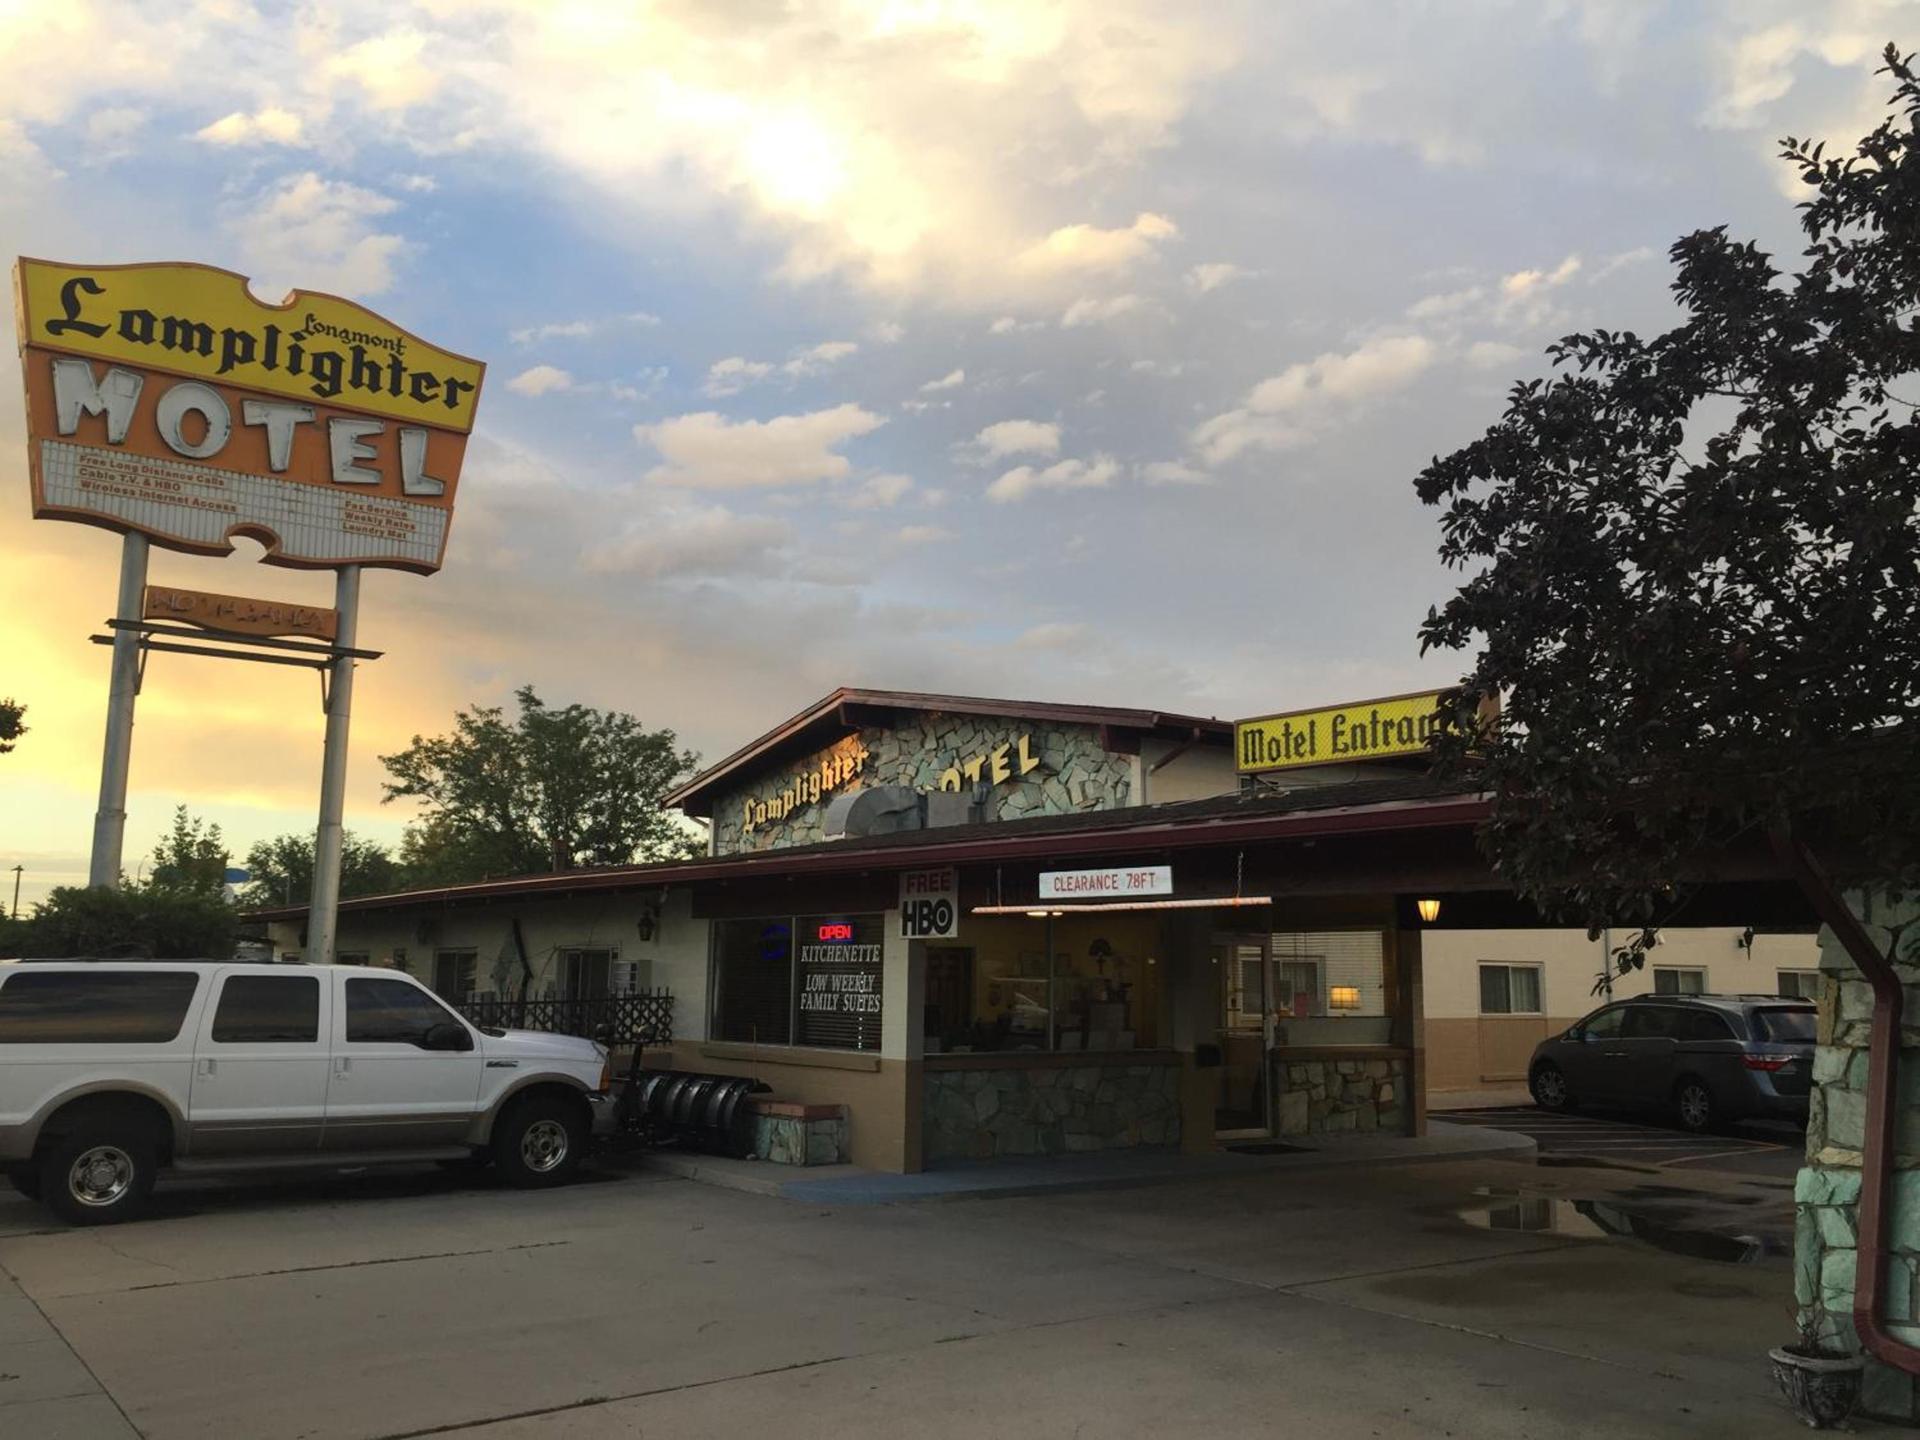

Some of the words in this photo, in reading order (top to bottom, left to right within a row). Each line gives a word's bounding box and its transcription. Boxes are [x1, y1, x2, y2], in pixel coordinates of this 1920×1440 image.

[45, 277, 476, 409] Lamplighter
[303, 313, 407, 354] Longmont
[51, 358, 446, 496] MOTEL
[79, 455, 107, 467] Free
[110, 459, 139, 473] Long
[141, 465, 194, 480] Distance
[196, 474, 225, 487] Calls
[79, 467, 116, 481] Cable
[143, 478, 152, 487] &
[155, 481, 182, 492] HBO
[80, 479, 136, 497] Wireless
[139, 489, 189, 504] Internet
[192, 498, 238, 513] Access
[344, 511, 383, 526] Weekly
[385, 518, 416, 531] Rates
[367, 505, 408, 517] Service
[343, 522, 385, 537] Laundry
[1243, 719, 1317, 764] Motel
[1331, 708, 1440, 754] Entran
[916, 734, 1040, 795] OTEL
[743, 747, 870, 835] Lamplighter
[907, 871, 952, 894] FREE
[1054, 874, 1119, 892] CLEARANCE
[902, 898, 953, 936] HBO
[818, 924, 853, 942] OPEN
[801, 944, 881, 962] KITCHENETTE
[805, 974, 828, 992] LOW
[832, 974, 876, 993] WEEKLY
[800, 993, 840, 1011] FAMILY
[843, 994, 881, 1013] SUITES
